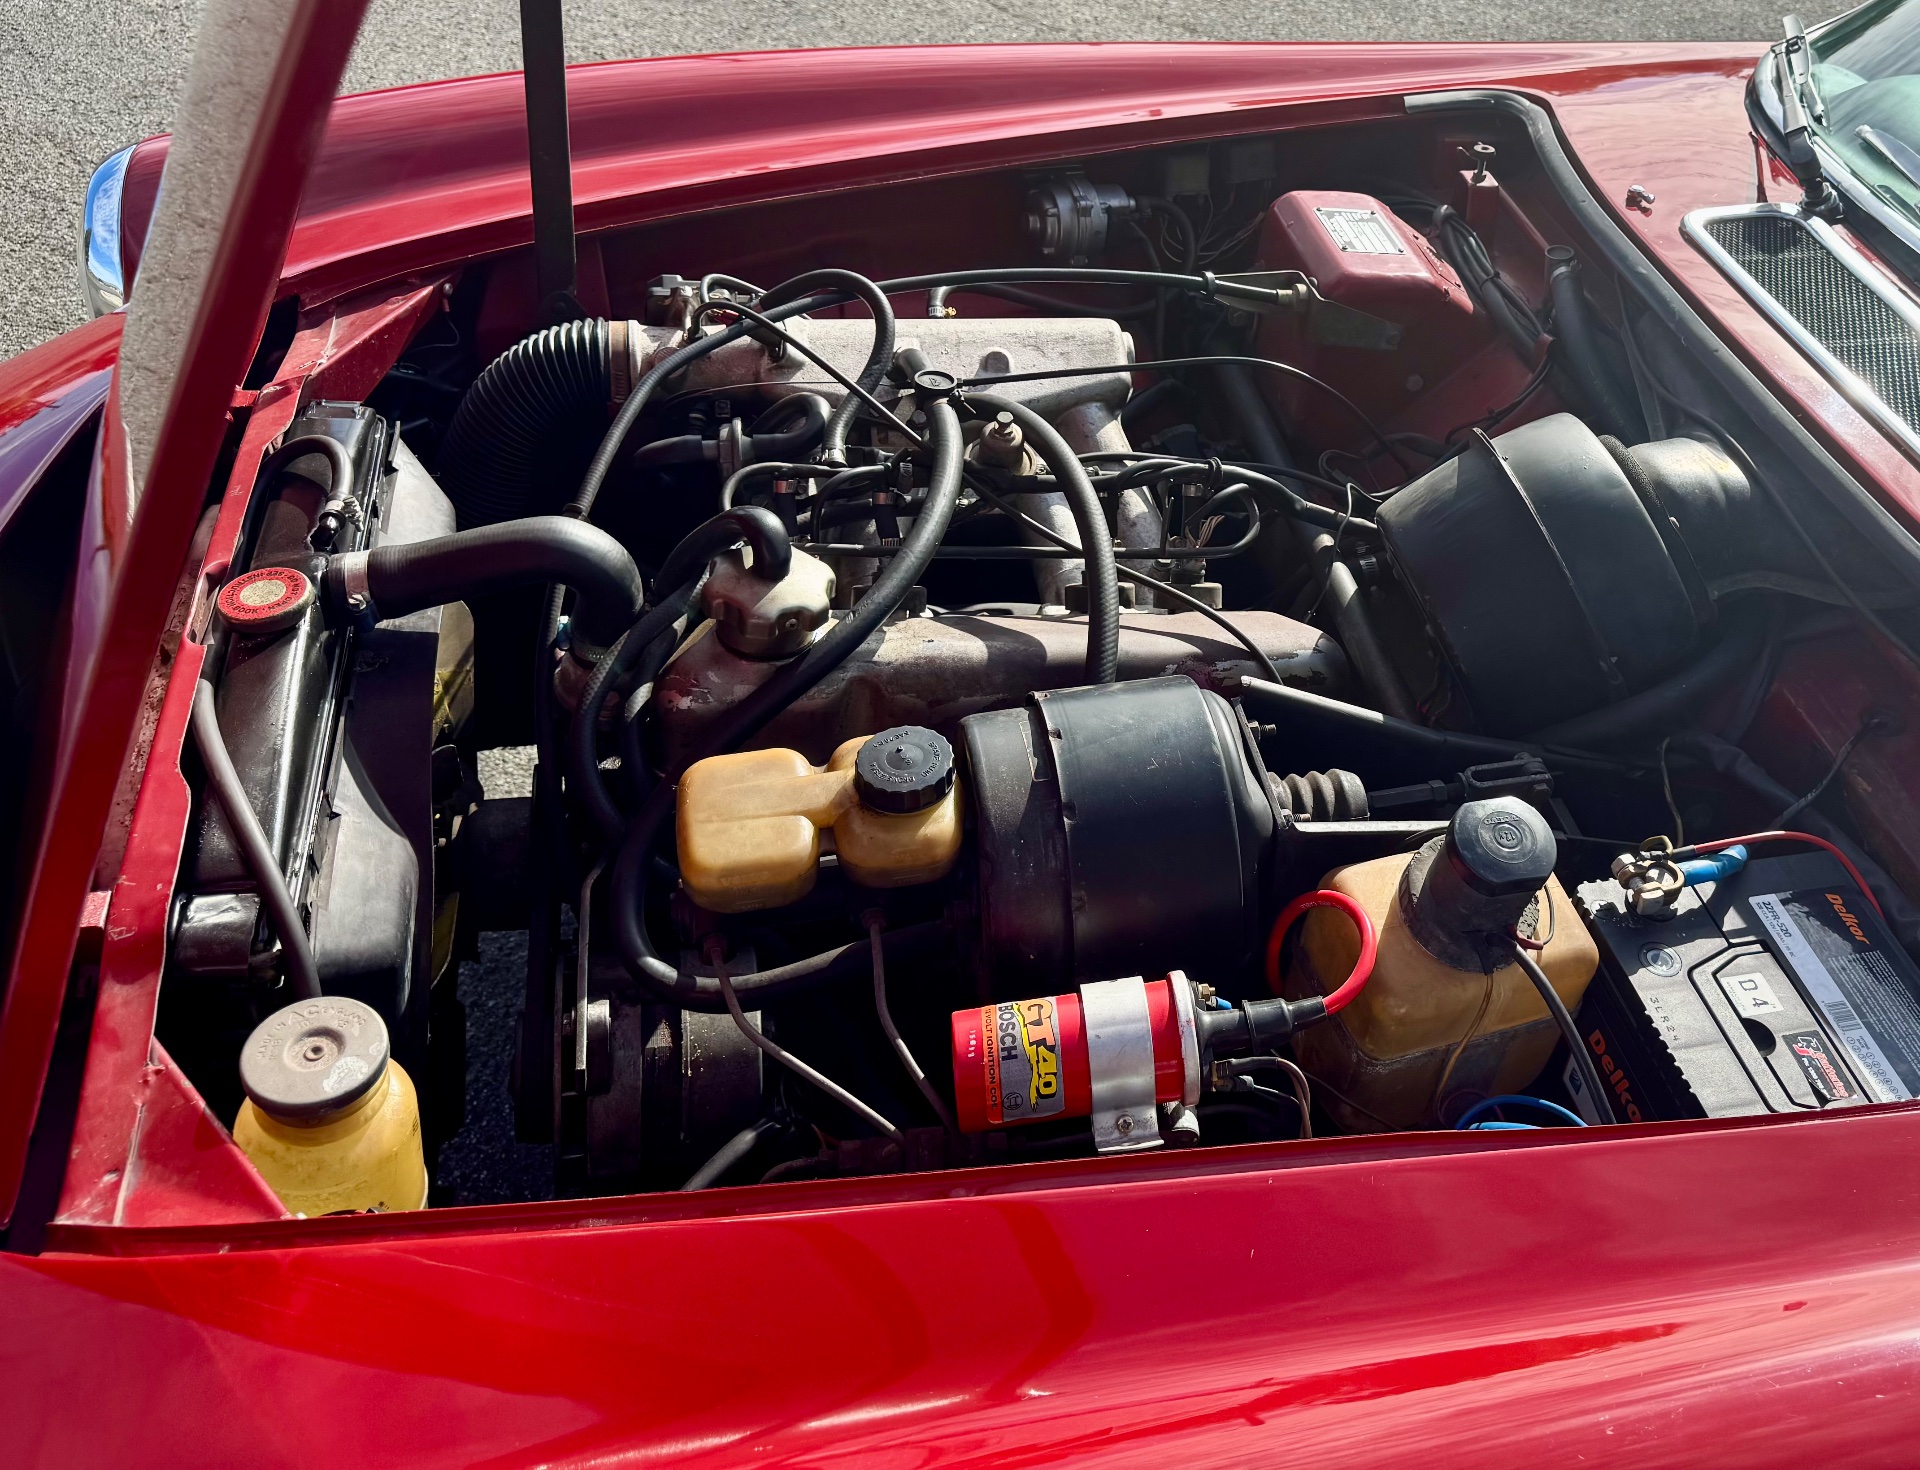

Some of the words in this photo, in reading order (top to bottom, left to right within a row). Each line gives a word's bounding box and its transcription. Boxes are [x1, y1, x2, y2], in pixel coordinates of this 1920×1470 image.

[267, 595, 293, 612] OPEN
[291, 583, 302, 596] NOT
[232, 605, 259, 614] BOOK
[1762, 900, 1792, 938] 22FR-520
[1824, 893, 1870, 945] Delkor
[288, 1004, 320, 1026] AC
[998, 1005, 1018, 1061] BOSCH
[986, 1035, 997, 1085] IGNITION
[1588, 1028, 1642, 1123] Delko
[989, 1087, 998, 1111] COIL
